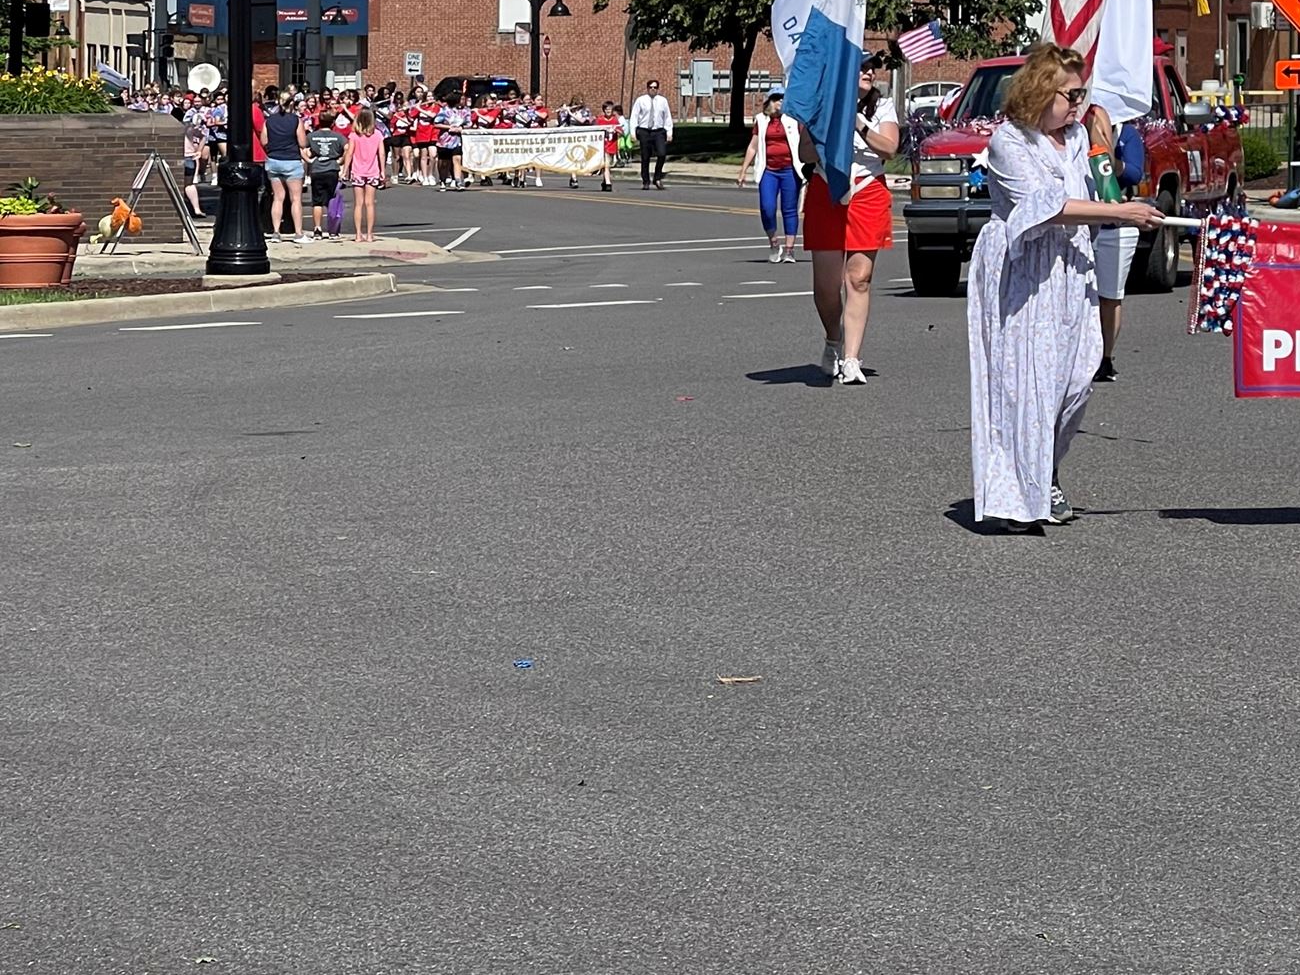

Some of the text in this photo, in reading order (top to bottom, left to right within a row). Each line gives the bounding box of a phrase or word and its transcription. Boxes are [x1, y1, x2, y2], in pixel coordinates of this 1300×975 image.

[493, 137, 546, 145] BELLEVILLE
[548, 135, 586, 144] DISTRICT
[1098, 159, 1113, 176] G
